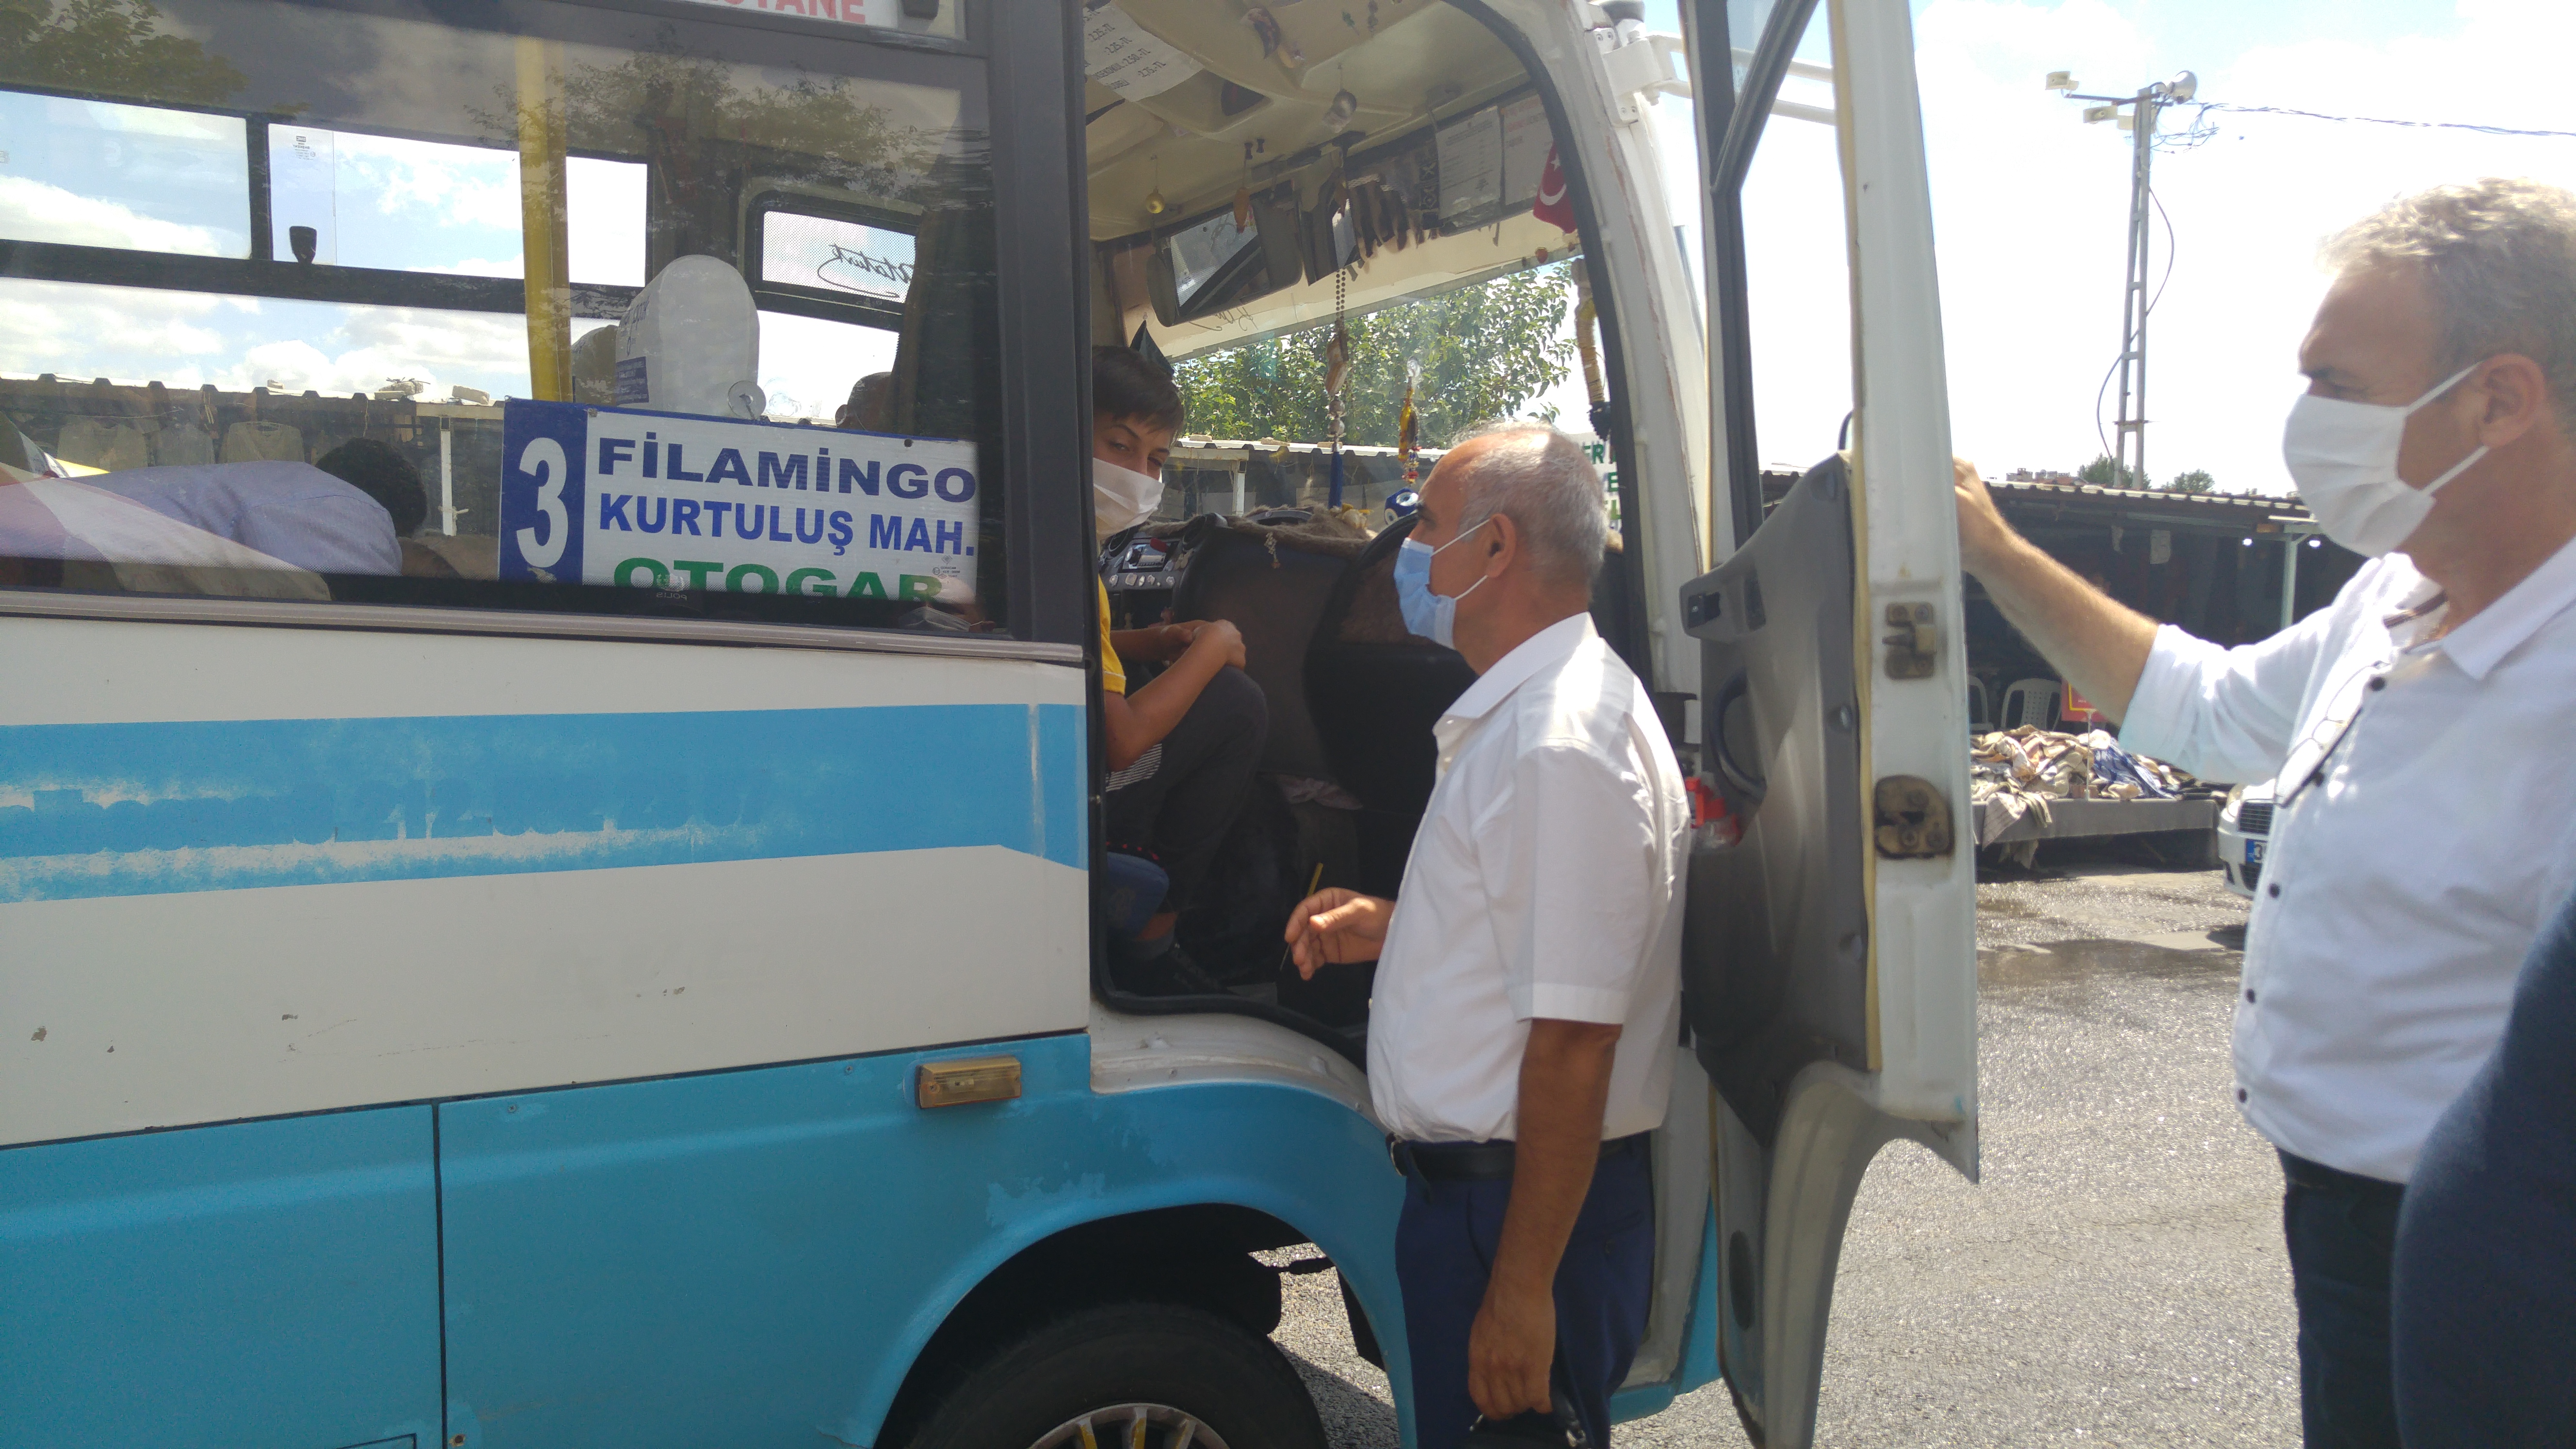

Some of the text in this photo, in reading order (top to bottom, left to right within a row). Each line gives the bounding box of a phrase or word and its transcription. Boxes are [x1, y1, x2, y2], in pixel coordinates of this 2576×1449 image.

[598, 432, 975, 502] FİLAMİNGO
[515, 437, 569, 568] 3
[599, 493, 975, 556] KURTULUŞ MAH.
